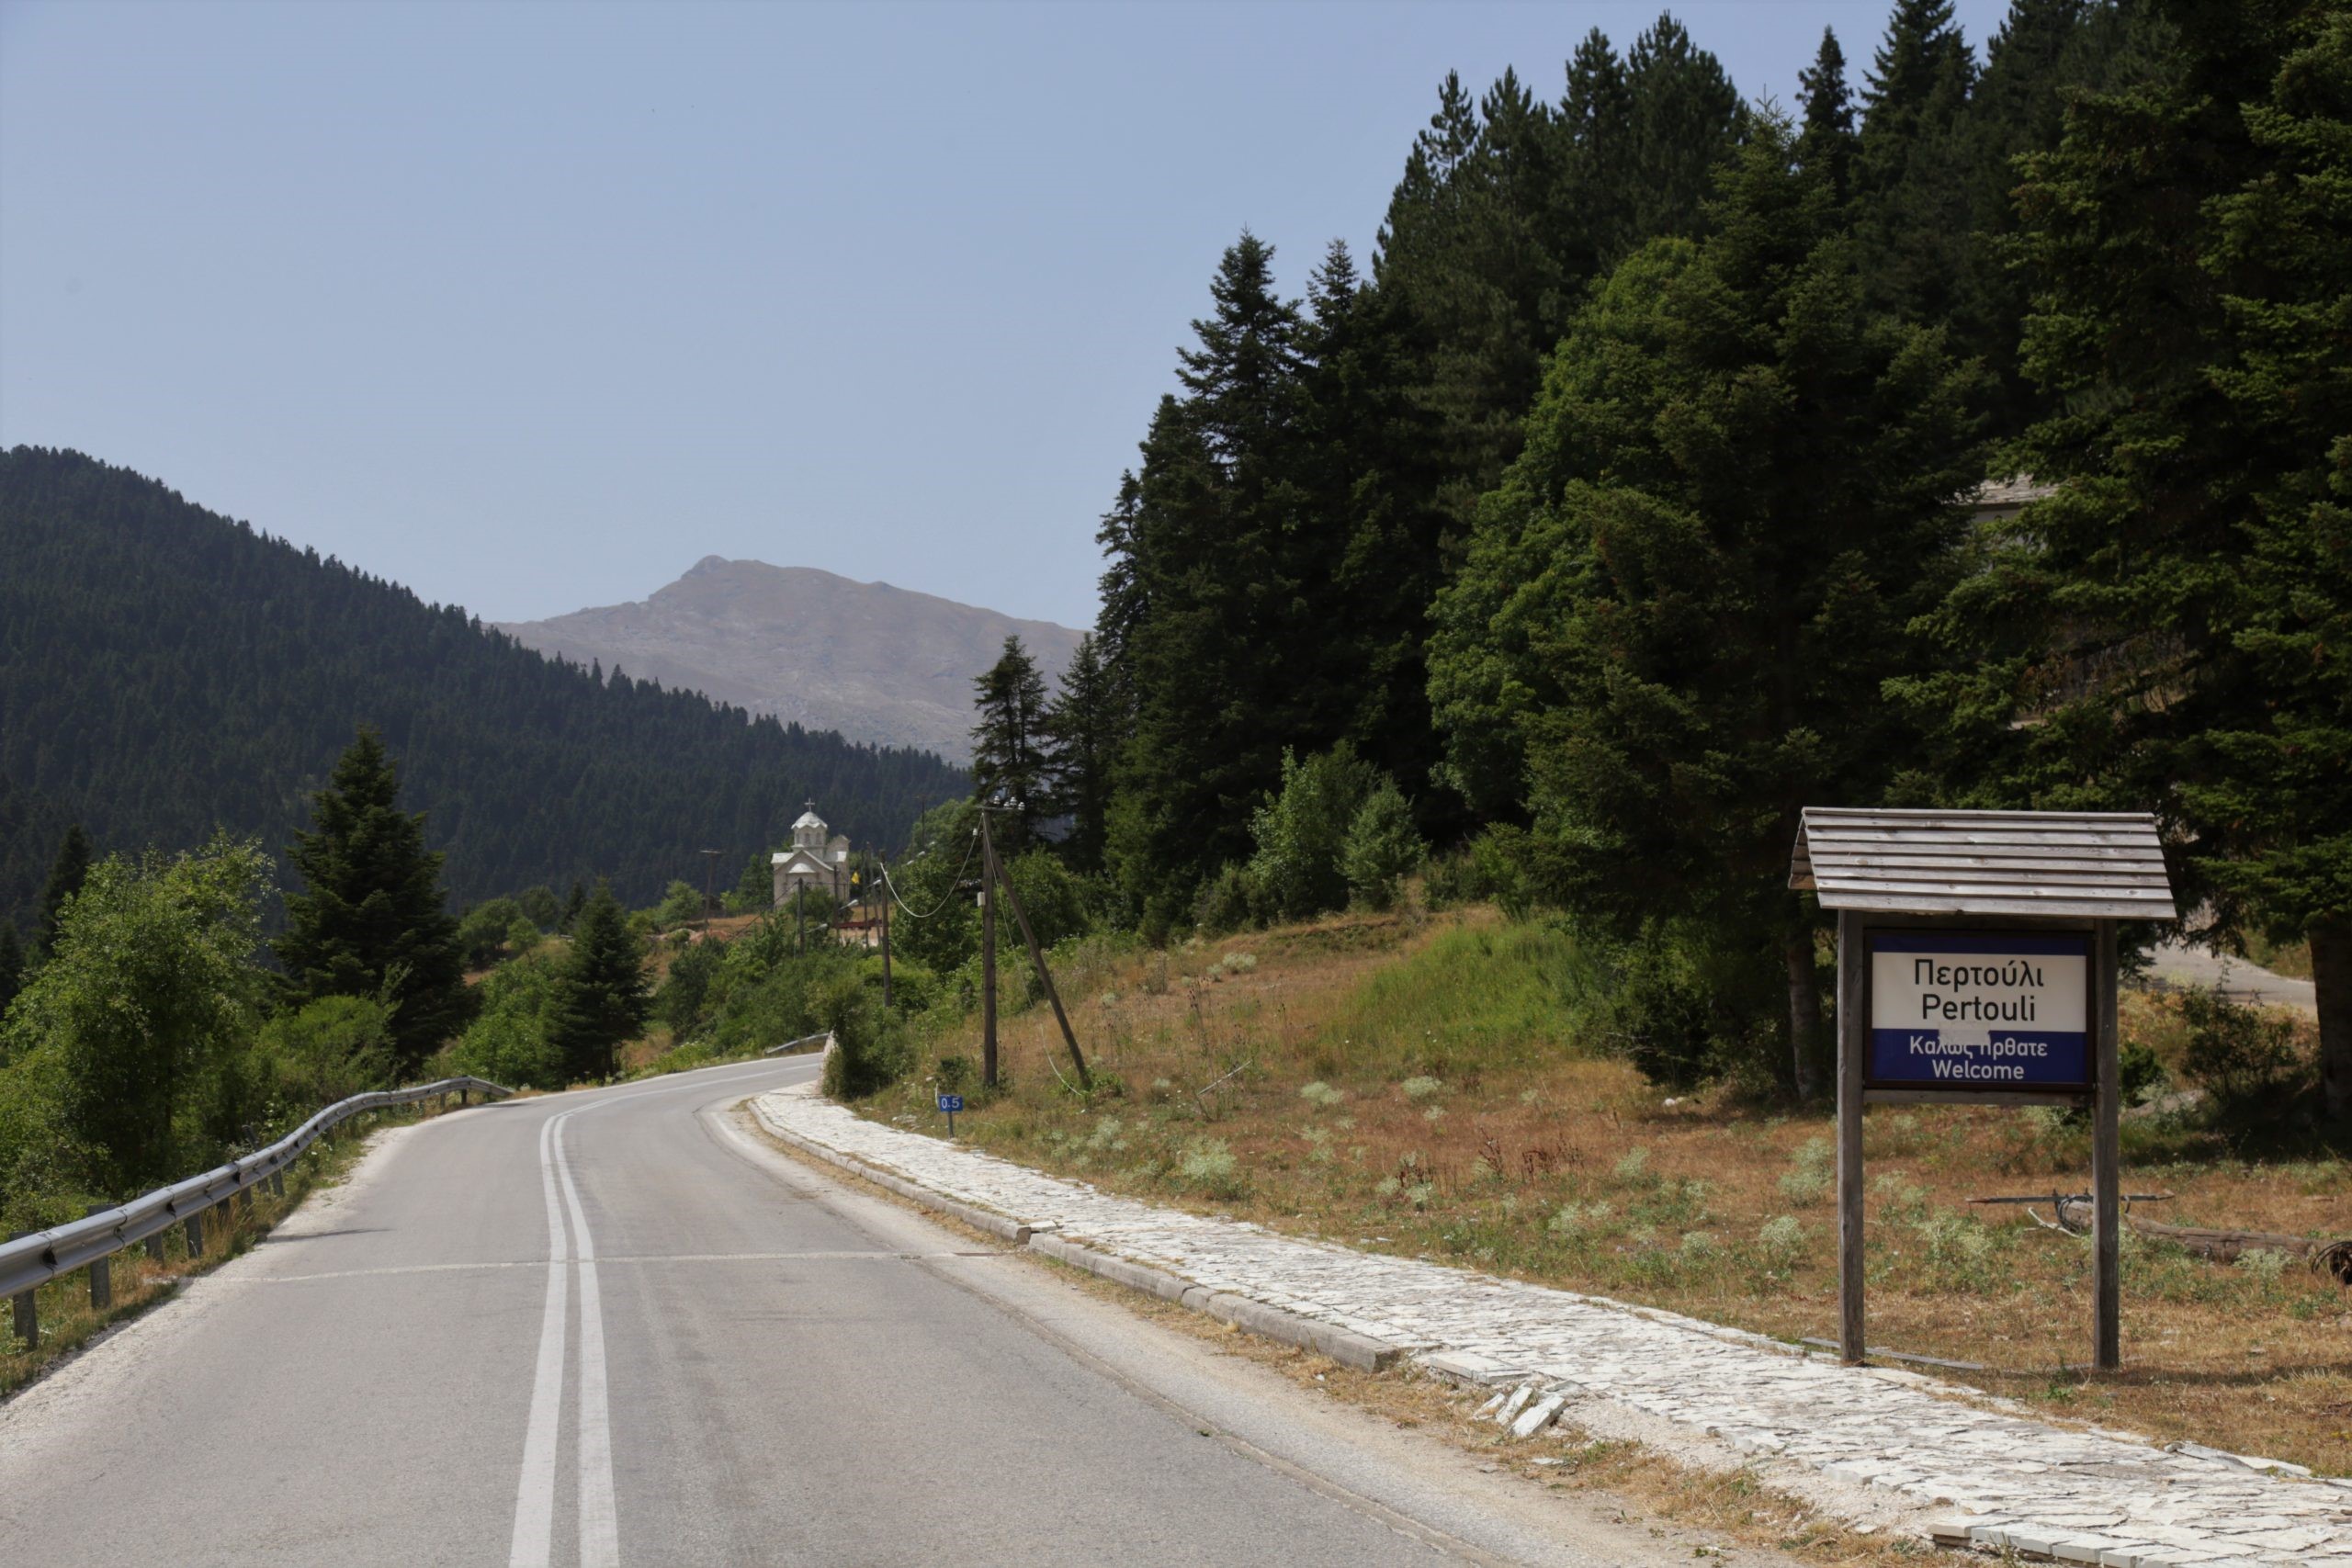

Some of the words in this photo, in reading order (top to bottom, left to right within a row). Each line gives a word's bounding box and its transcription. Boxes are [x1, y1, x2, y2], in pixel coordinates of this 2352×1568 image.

[1915, 958, 2044, 992] Περτούλι
[1921, 993, 2036, 1021] Pertouli
[1931, 1059, 2025, 1079] Welcome
[941, 1098, 960, 1109] 0.5
